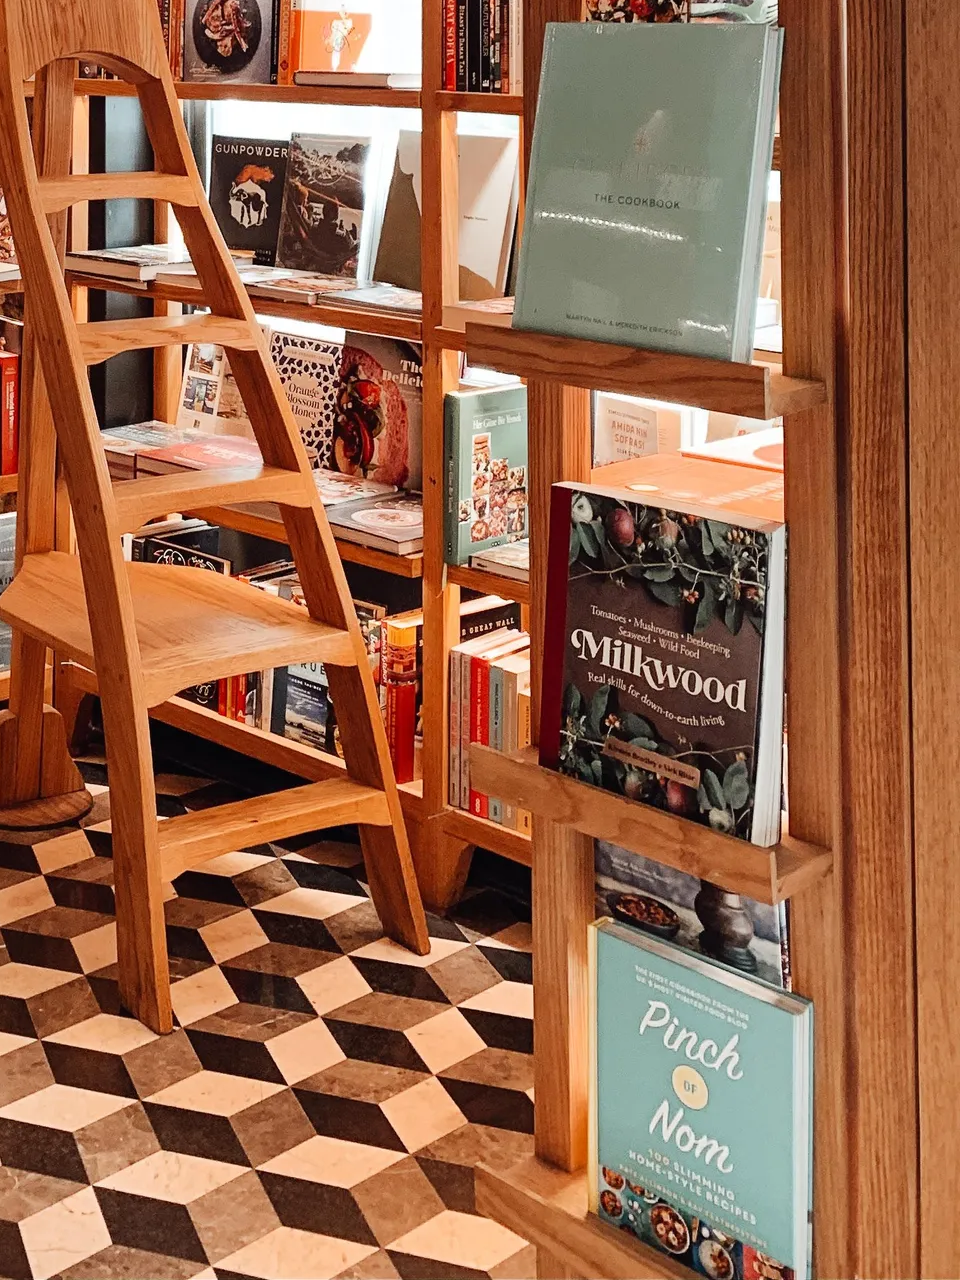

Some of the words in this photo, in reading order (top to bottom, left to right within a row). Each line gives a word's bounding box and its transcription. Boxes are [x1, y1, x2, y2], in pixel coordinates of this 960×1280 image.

[446, 26, 456, 64] SOFRA
[215, 143, 289, 158] GUNPOWDER
[593, 193, 615, 205] THE
[618, 194, 681, 210] COOKBOOK
[288, 382, 319, 398] Orange
[614, 433, 646, 451] SOFRASI
[469, 622, 493, 635] GREAT
[496, 617, 515, 628] WALL
[590, 604, 627, 625] Tomatoes
[633, 615, 680, 638] Mushrooms
[686, 631, 731, 658] Beekeeping
[617, 625, 651, 645] Seaweed
[659, 637, 680, 652] Wild
[681, 643, 701, 660] Food
[570, 627, 747, 712] Milkwood
[587, 671, 606, 685] Real
[607, 676, 628, 693] skills
[628, 684, 641, 699] for
[640, 692, 700, 727] down-to-earth
[700, 713, 726, 729] living
[635, 964, 648, 976] THE
[669, 978, 711, 1003] COOKBOOK
[712, 997, 735, 1015] FROM
[736, 1008, 750, 1022] THE
[704, 1003, 727, 1019] FOOD
[727, 1016, 748, 1030] BLOG
[638, 998, 744, 1081] Pinch
[683, 1079, 699, 1094] OF
[648, 1097, 734, 1175] Nom
[628, 1149, 703, 1198] HOME-STYLE
[705, 1189, 757, 1226] RECIPES
[648, 1147, 670, 1166] 100
[673, 1161, 736, 1202] SLIMMING
